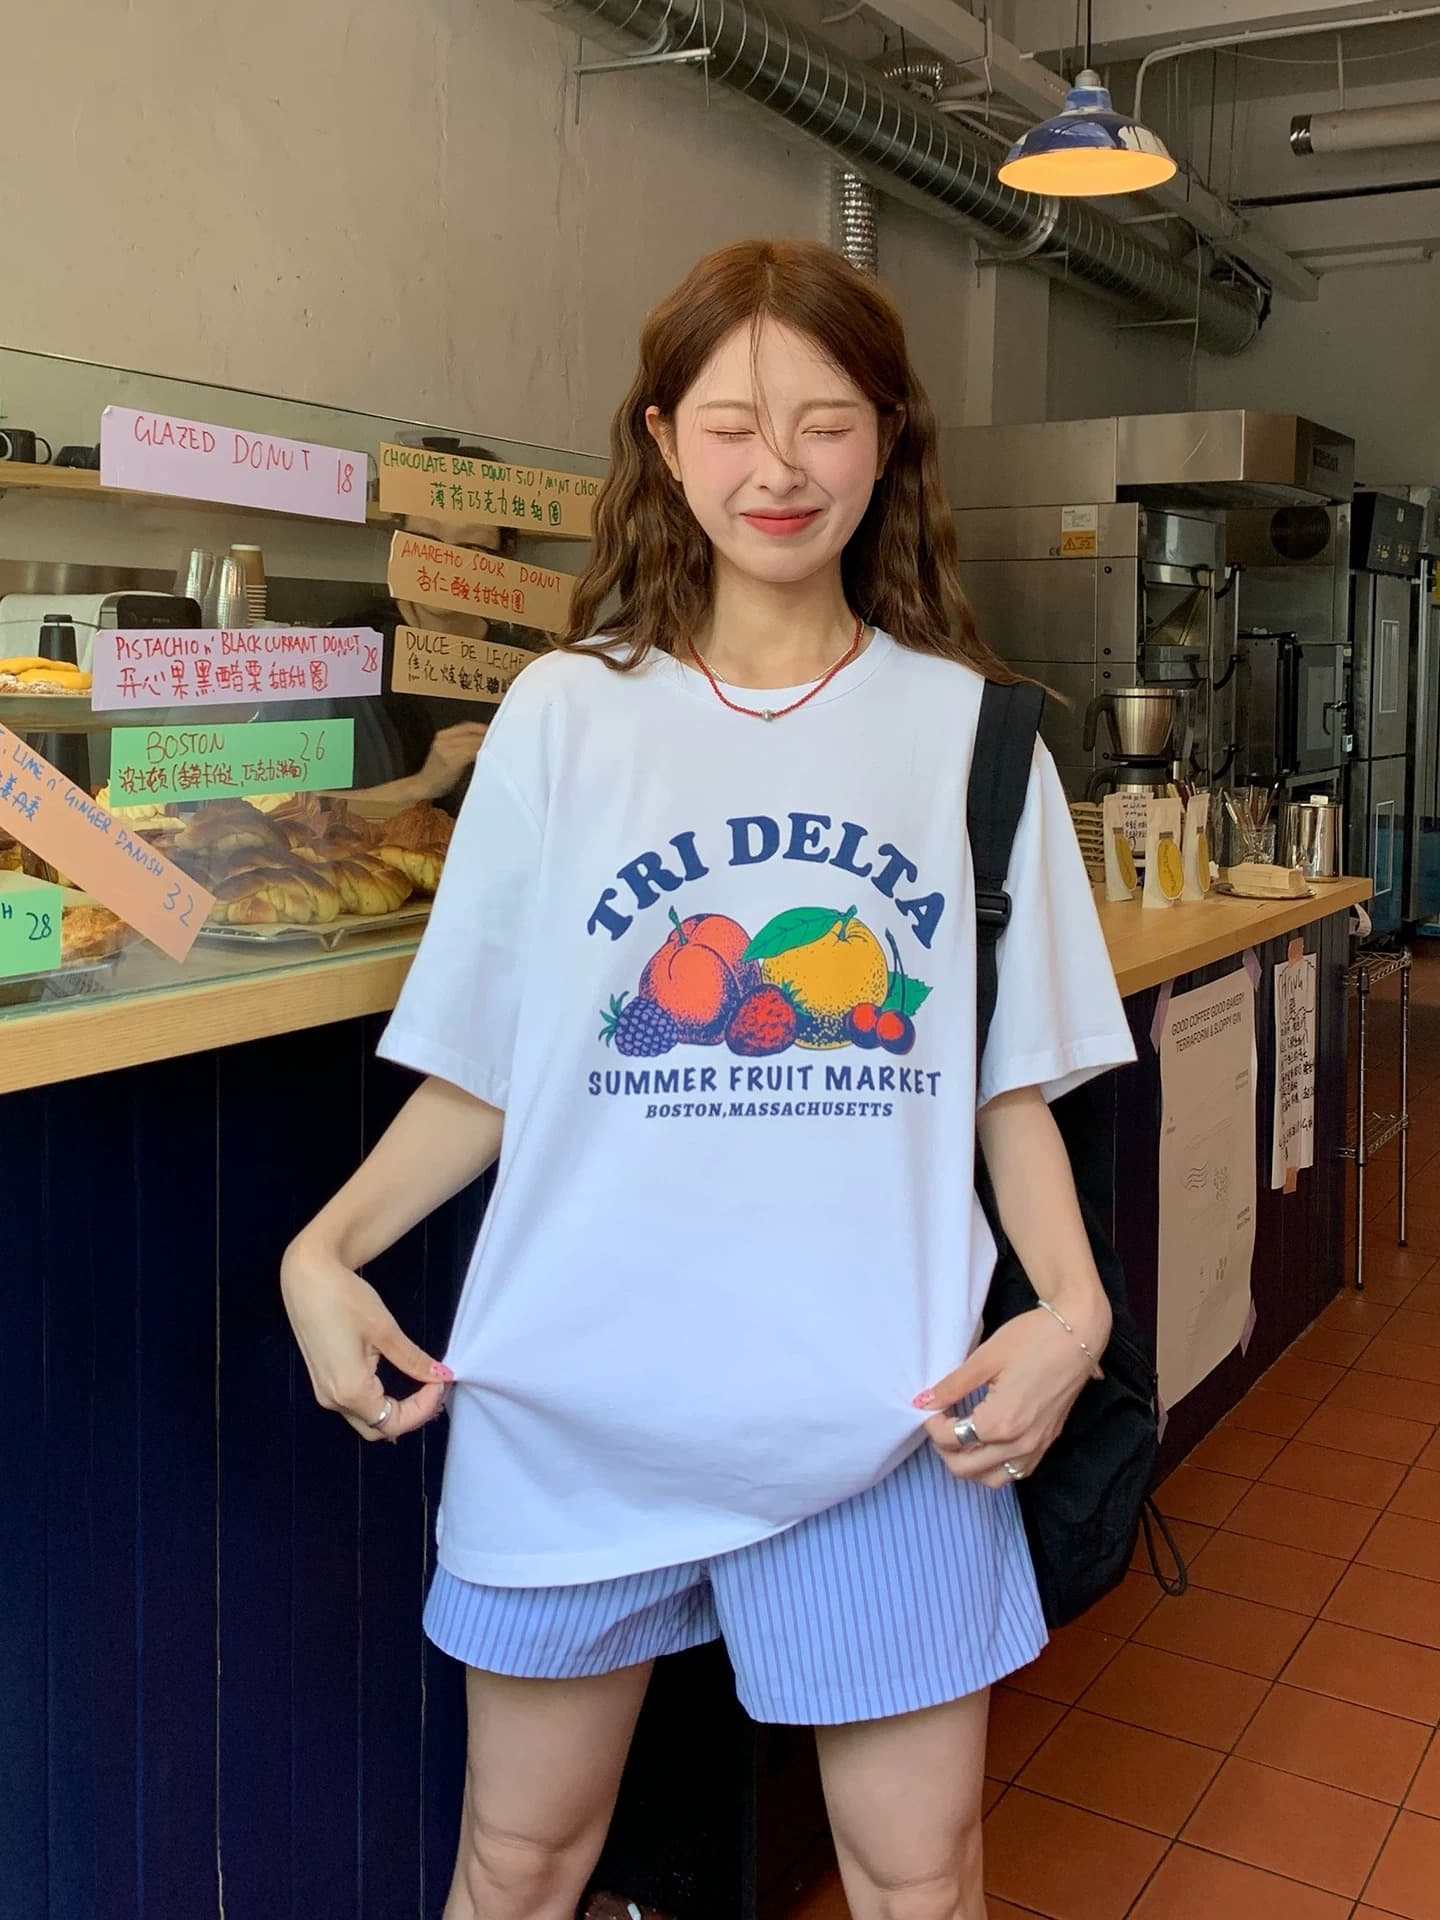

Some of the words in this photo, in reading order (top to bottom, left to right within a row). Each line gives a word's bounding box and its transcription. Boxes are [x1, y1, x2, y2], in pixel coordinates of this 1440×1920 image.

[134, 415, 215, 452] GLAZED
[232, 434, 310, 471] DONUT
[336, 460, 354, 494] 18
[383, 448, 447, 473] CHOCOLATE
[452, 458, 475, 476] BAR
[401, 540, 463, 569] AMARETTO
[472, 553, 505, 578] SOUR
[520, 567, 561, 592] DONUT
[116, 636, 198, 661] PISTACHIO
[221, 632, 261, 653] BLACK
[264, 634, 317, 653] CURRANT
[323, 634, 360, 656] DONUT
[362, 645, 378, 672] 28
[406, 631, 450, 655] DULCE
[461, 642, 477, 659] DE
[487, 647, 526, 670] LECHE
[146, 731, 225, 763] BOSTON
[299, 731, 325, 761] 26
[12, 743, 45, 780] LIME
[64, 787, 112, 833] GINGER
[115, 828, 164, 876] DANISH
[163, 882, 194, 927] 32
[587, 831, 709, 941] TRI
[726, 812, 945, 949] DELTA
[26, 912, 52, 940] 28
[1171, 1018, 1189, 1036] GOOD
[1189, 1007, 1210, 1028] COFFEE
[1211, 1000, 1226, 1018] GOOD
[588, 1066, 717, 1096] SUMMER
[729, 1064, 813, 1093] FRUIT
[825, 1064, 941, 1097] MARKET
